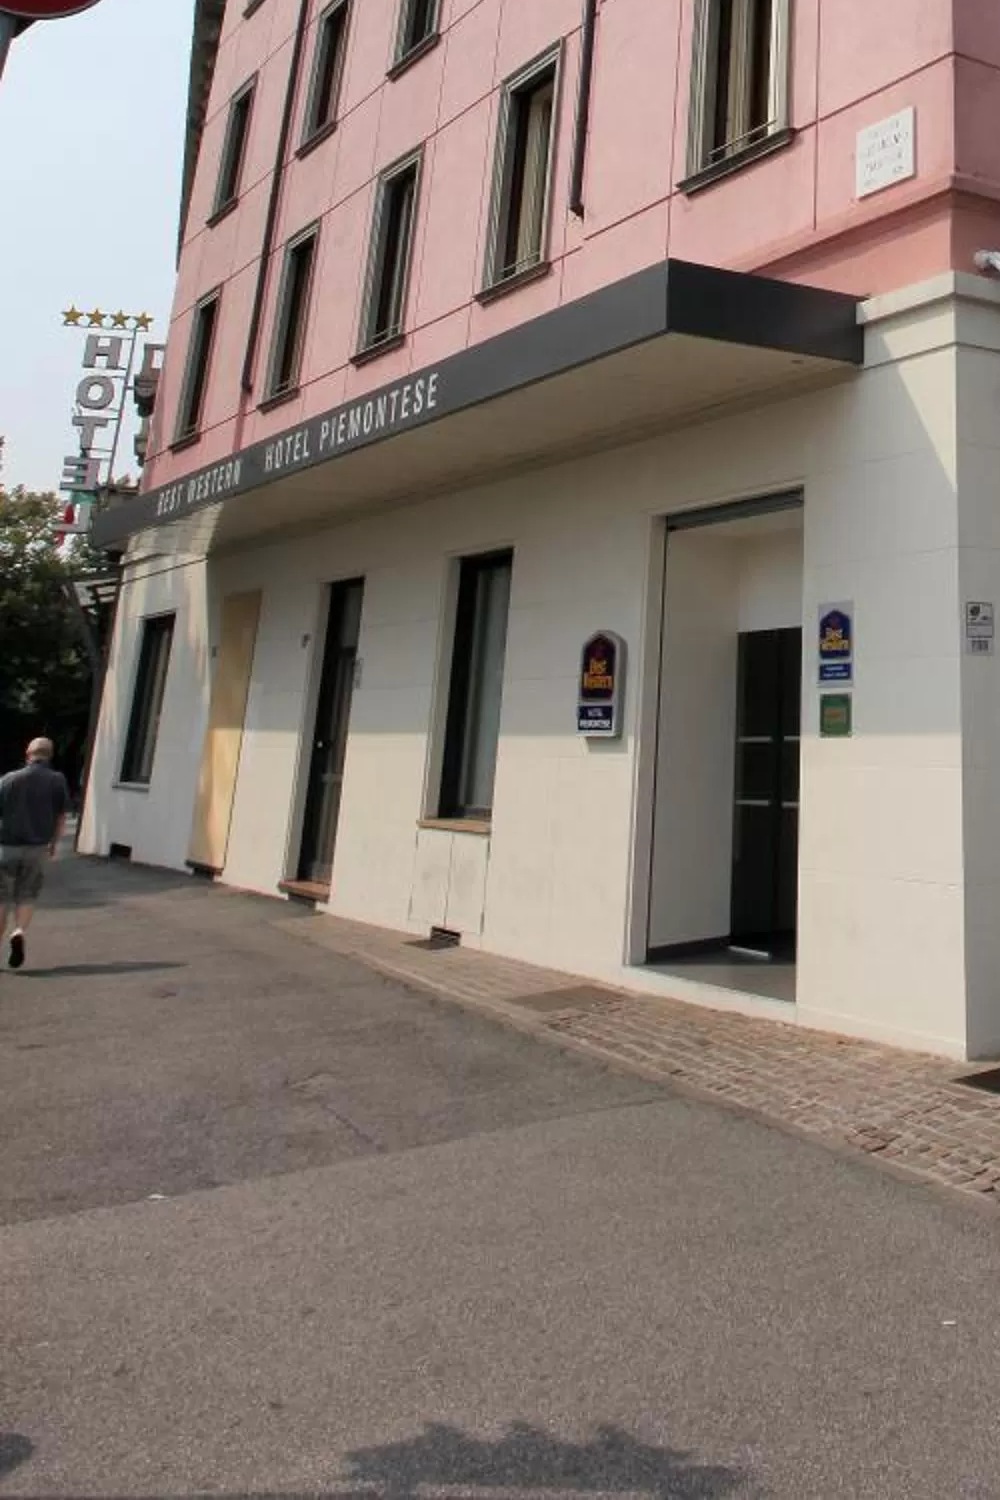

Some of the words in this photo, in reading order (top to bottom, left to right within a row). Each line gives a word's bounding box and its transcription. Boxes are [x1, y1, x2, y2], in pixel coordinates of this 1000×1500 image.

[157, 482, 185, 516] BEST
[187, 458, 244, 503] WESTERN
[263, 428, 310, 472] HOTEL
[319, 372, 439, 450] PIEMONTESE
